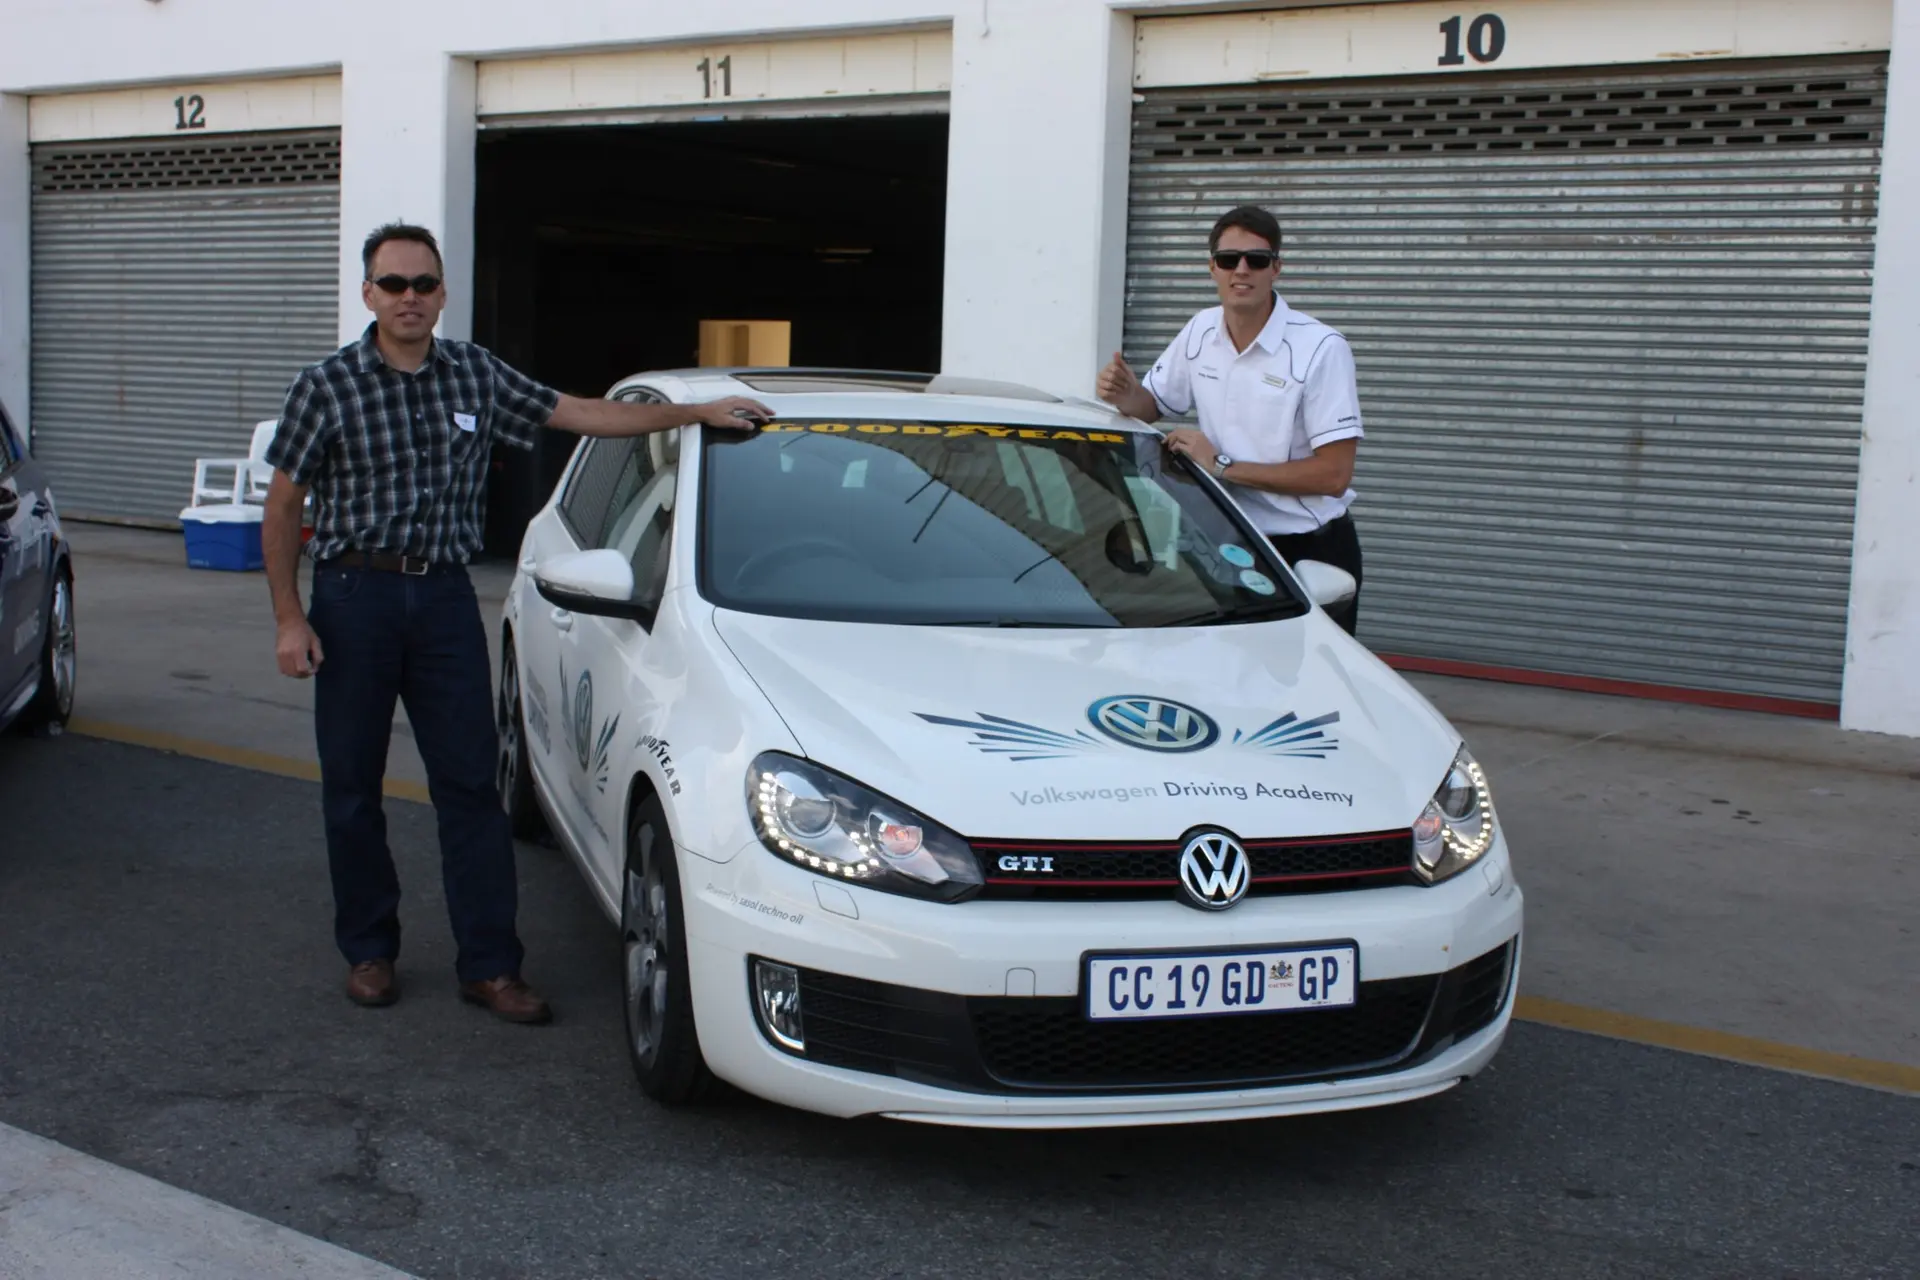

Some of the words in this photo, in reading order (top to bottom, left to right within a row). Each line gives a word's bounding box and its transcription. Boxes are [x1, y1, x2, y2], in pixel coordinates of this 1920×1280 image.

[1438, 13, 1505, 66] 10
[696, 55, 731, 98] 11
[174, 95, 205, 129] 12
[1010, 786, 1158, 806] Volkswagen
[1163, 781, 1249, 800] Driving
[1256, 782, 1354, 807] Academy
[998, 855, 1054, 872] GTI
[758, 903, 789, 920] techno
[789, 913, 804, 925] oil
[1108, 966, 1154, 1011] CC
[1167, 964, 1210, 1009] 19
[1222, 961, 1265, 1006] GD
[1299, 956, 1339, 1001] GP
